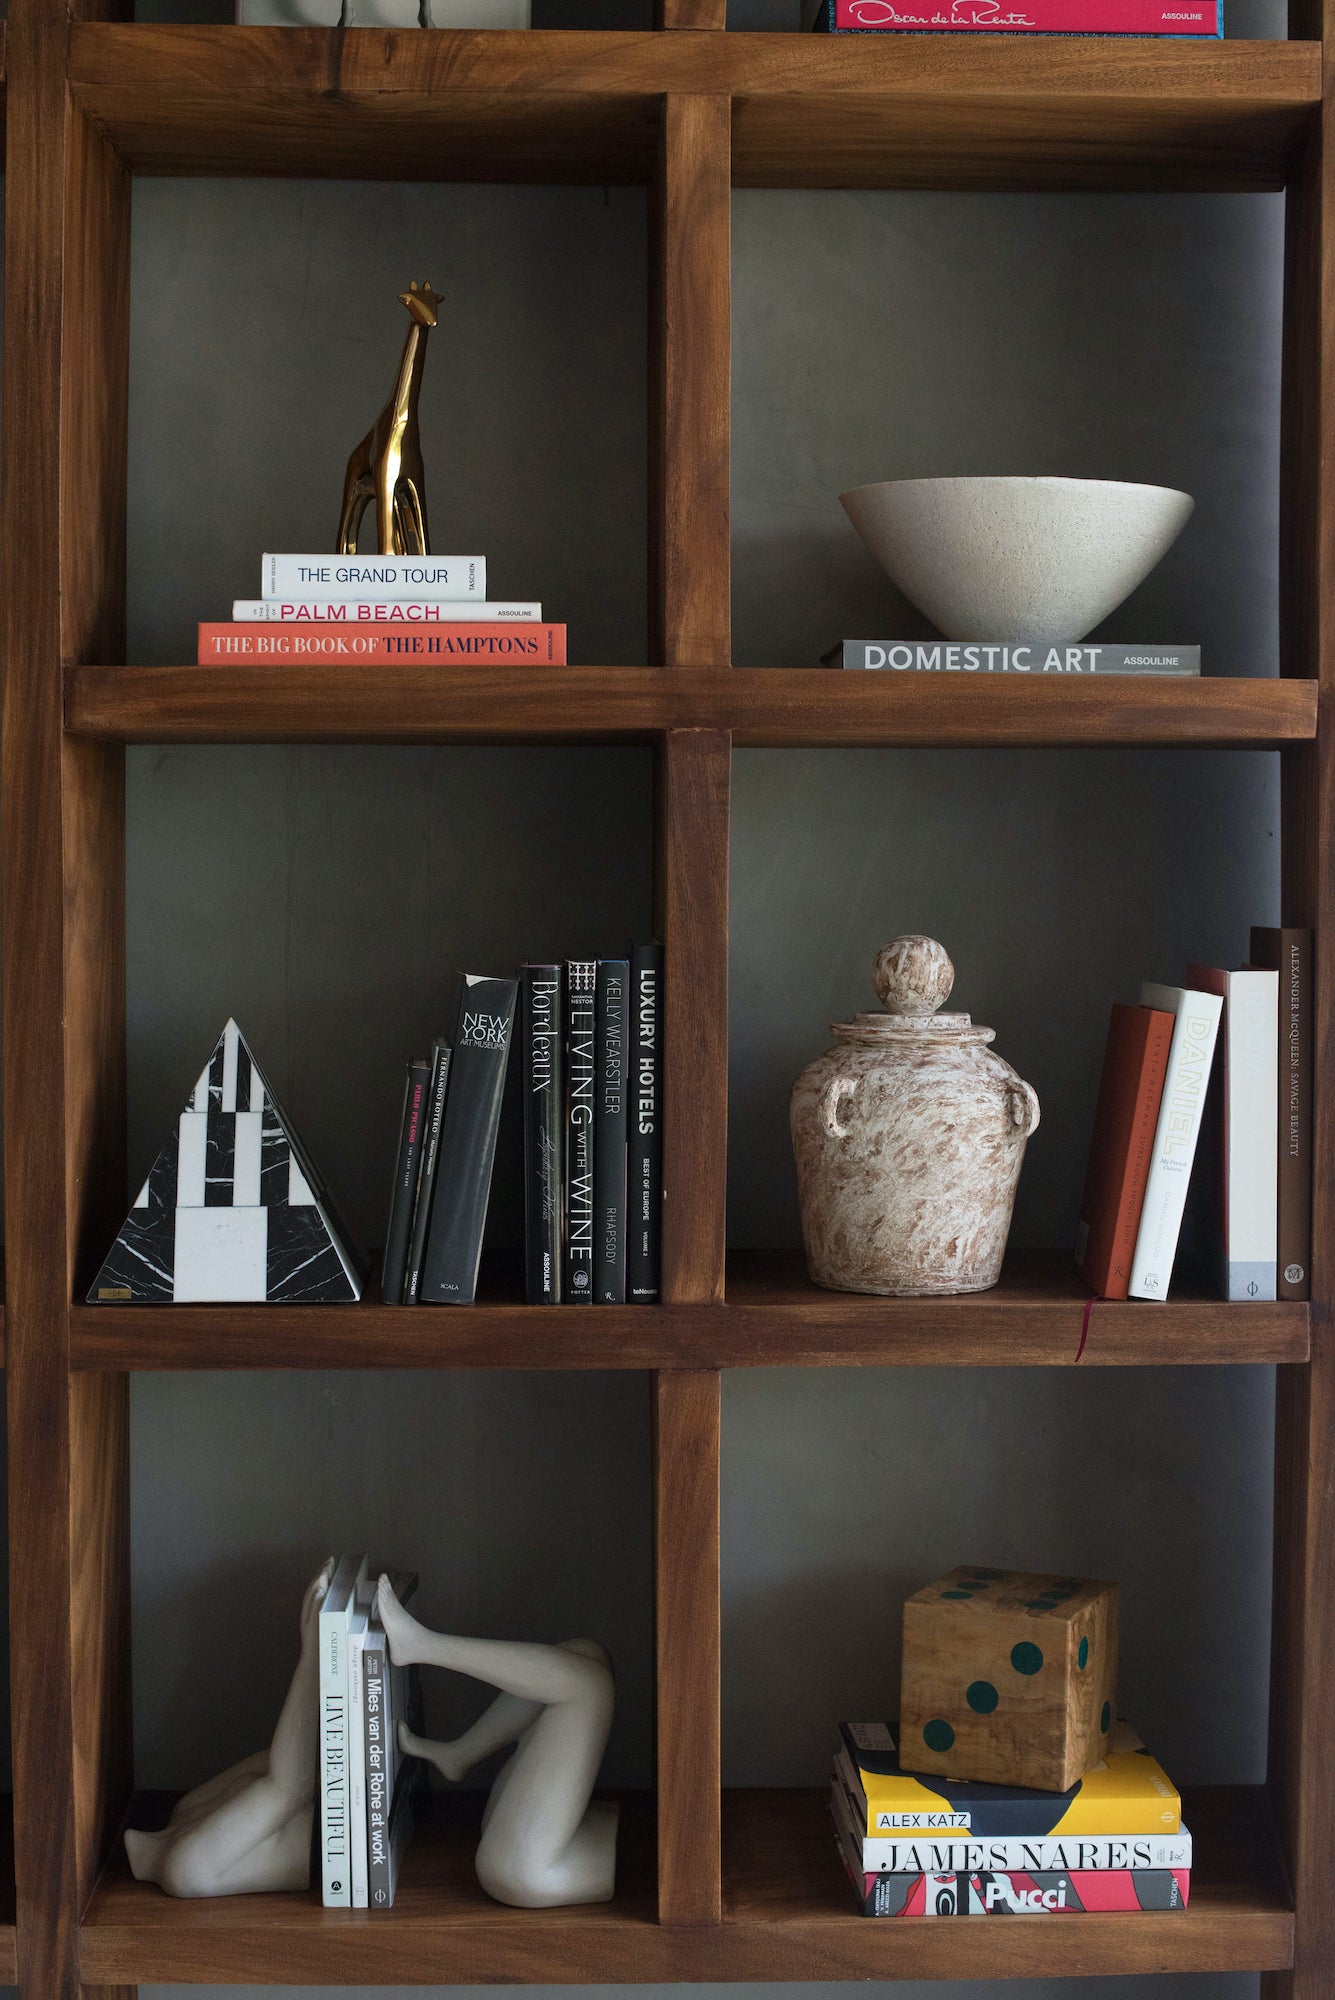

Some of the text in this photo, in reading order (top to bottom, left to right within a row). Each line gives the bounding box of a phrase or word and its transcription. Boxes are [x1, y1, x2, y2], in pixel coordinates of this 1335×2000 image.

[849, 0, 930, 24] Oscar
[930, 14, 947, 23] de
[951, 0, 1035, 27] Renta
[298, 568, 448, 583] THE GRAND TOUR
[281, 605, 440, 620] PALM BEACH
[212, 637, 537, 653] THE BIG BOOK OF THE HAMPTONS
[865, 646, 1101, 671] DOMESTIC ART
[1123, 657, 1178, 665] ASSOULINE
[1291, 945, 1299, 1011] ALEXANDER
[461, 1027, 506, 1044] YORK
[464, 1013, 510, 1030] NEW
[460, 1038, 506, 1051] ART MUSEUMS
[532, 981, 558, 1093] Bordeaux
[605, 978, 622, 1114] KELLY WEARSTLER
[638, 969, 656, 1134] LUXURY HOTELS
[432, 1056, 448, 1133] FERNANDO BOTERO
[1162, 1015, 1213, 1156] DANIEL
[1290, 1073, 1298, 1112] SAVAGE
[409, 1084, 422, 1143] PABLO PICASSO
[570, 1012, 593, 1260] LIVING WITH WINE
[1289, 1115, 1299, 1157] BEAUTY
[1160, 1157, 1170, 1166] My
[643, 1180, 650, 1189] OF
[1162, 1191, 1172, 1222] DANIEL
[606, 1208, 617, 1265] RHAPSODY
[410, 1271, 418, 1296] TASCHEN
[440, 1283, 459, 1291] SCALA
[330, 1631, 338, 1676] CALDERONE
[326, 1696, 345, 1862] LIVE BEAUTIFUL
[367, 1678, 386, 1864] Mies van der Rohe at work
[880, 1813, 967, 1827] ALEX KATZ
[881, 1844, 1008, 1871] JAMES
[1019, 1842, 1152, 1869] NARES
[985, 1880, 1066, 1909] Pucci
[1170, 1878, 1178, 1909] TASCHEN
